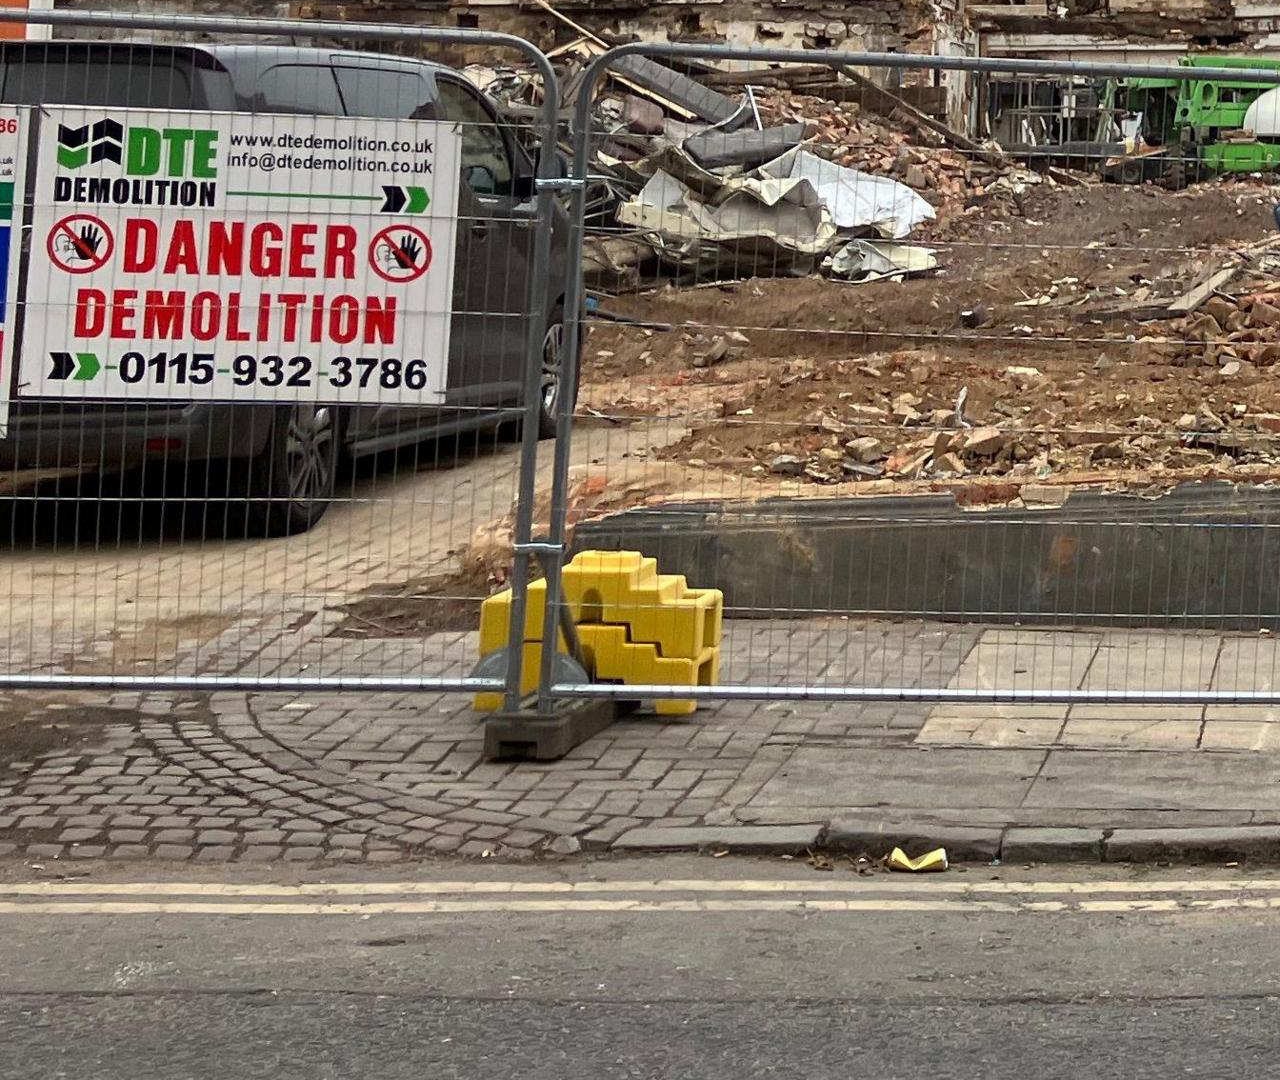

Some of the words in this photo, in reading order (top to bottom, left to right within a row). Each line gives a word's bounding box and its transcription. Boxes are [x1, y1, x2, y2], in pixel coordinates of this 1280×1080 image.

[127, 127, 219, 178] DTE
[227, 152, 433, 174] info@dtedemolition.co.uk
[230, 133, 433, 153] www.dtedemolition.co.uk
[54, 176, 216, 207] DEMOLITION
[123, 218, 358, 280] DANGER
[74, 288, 396, 345] DEMOLITION
